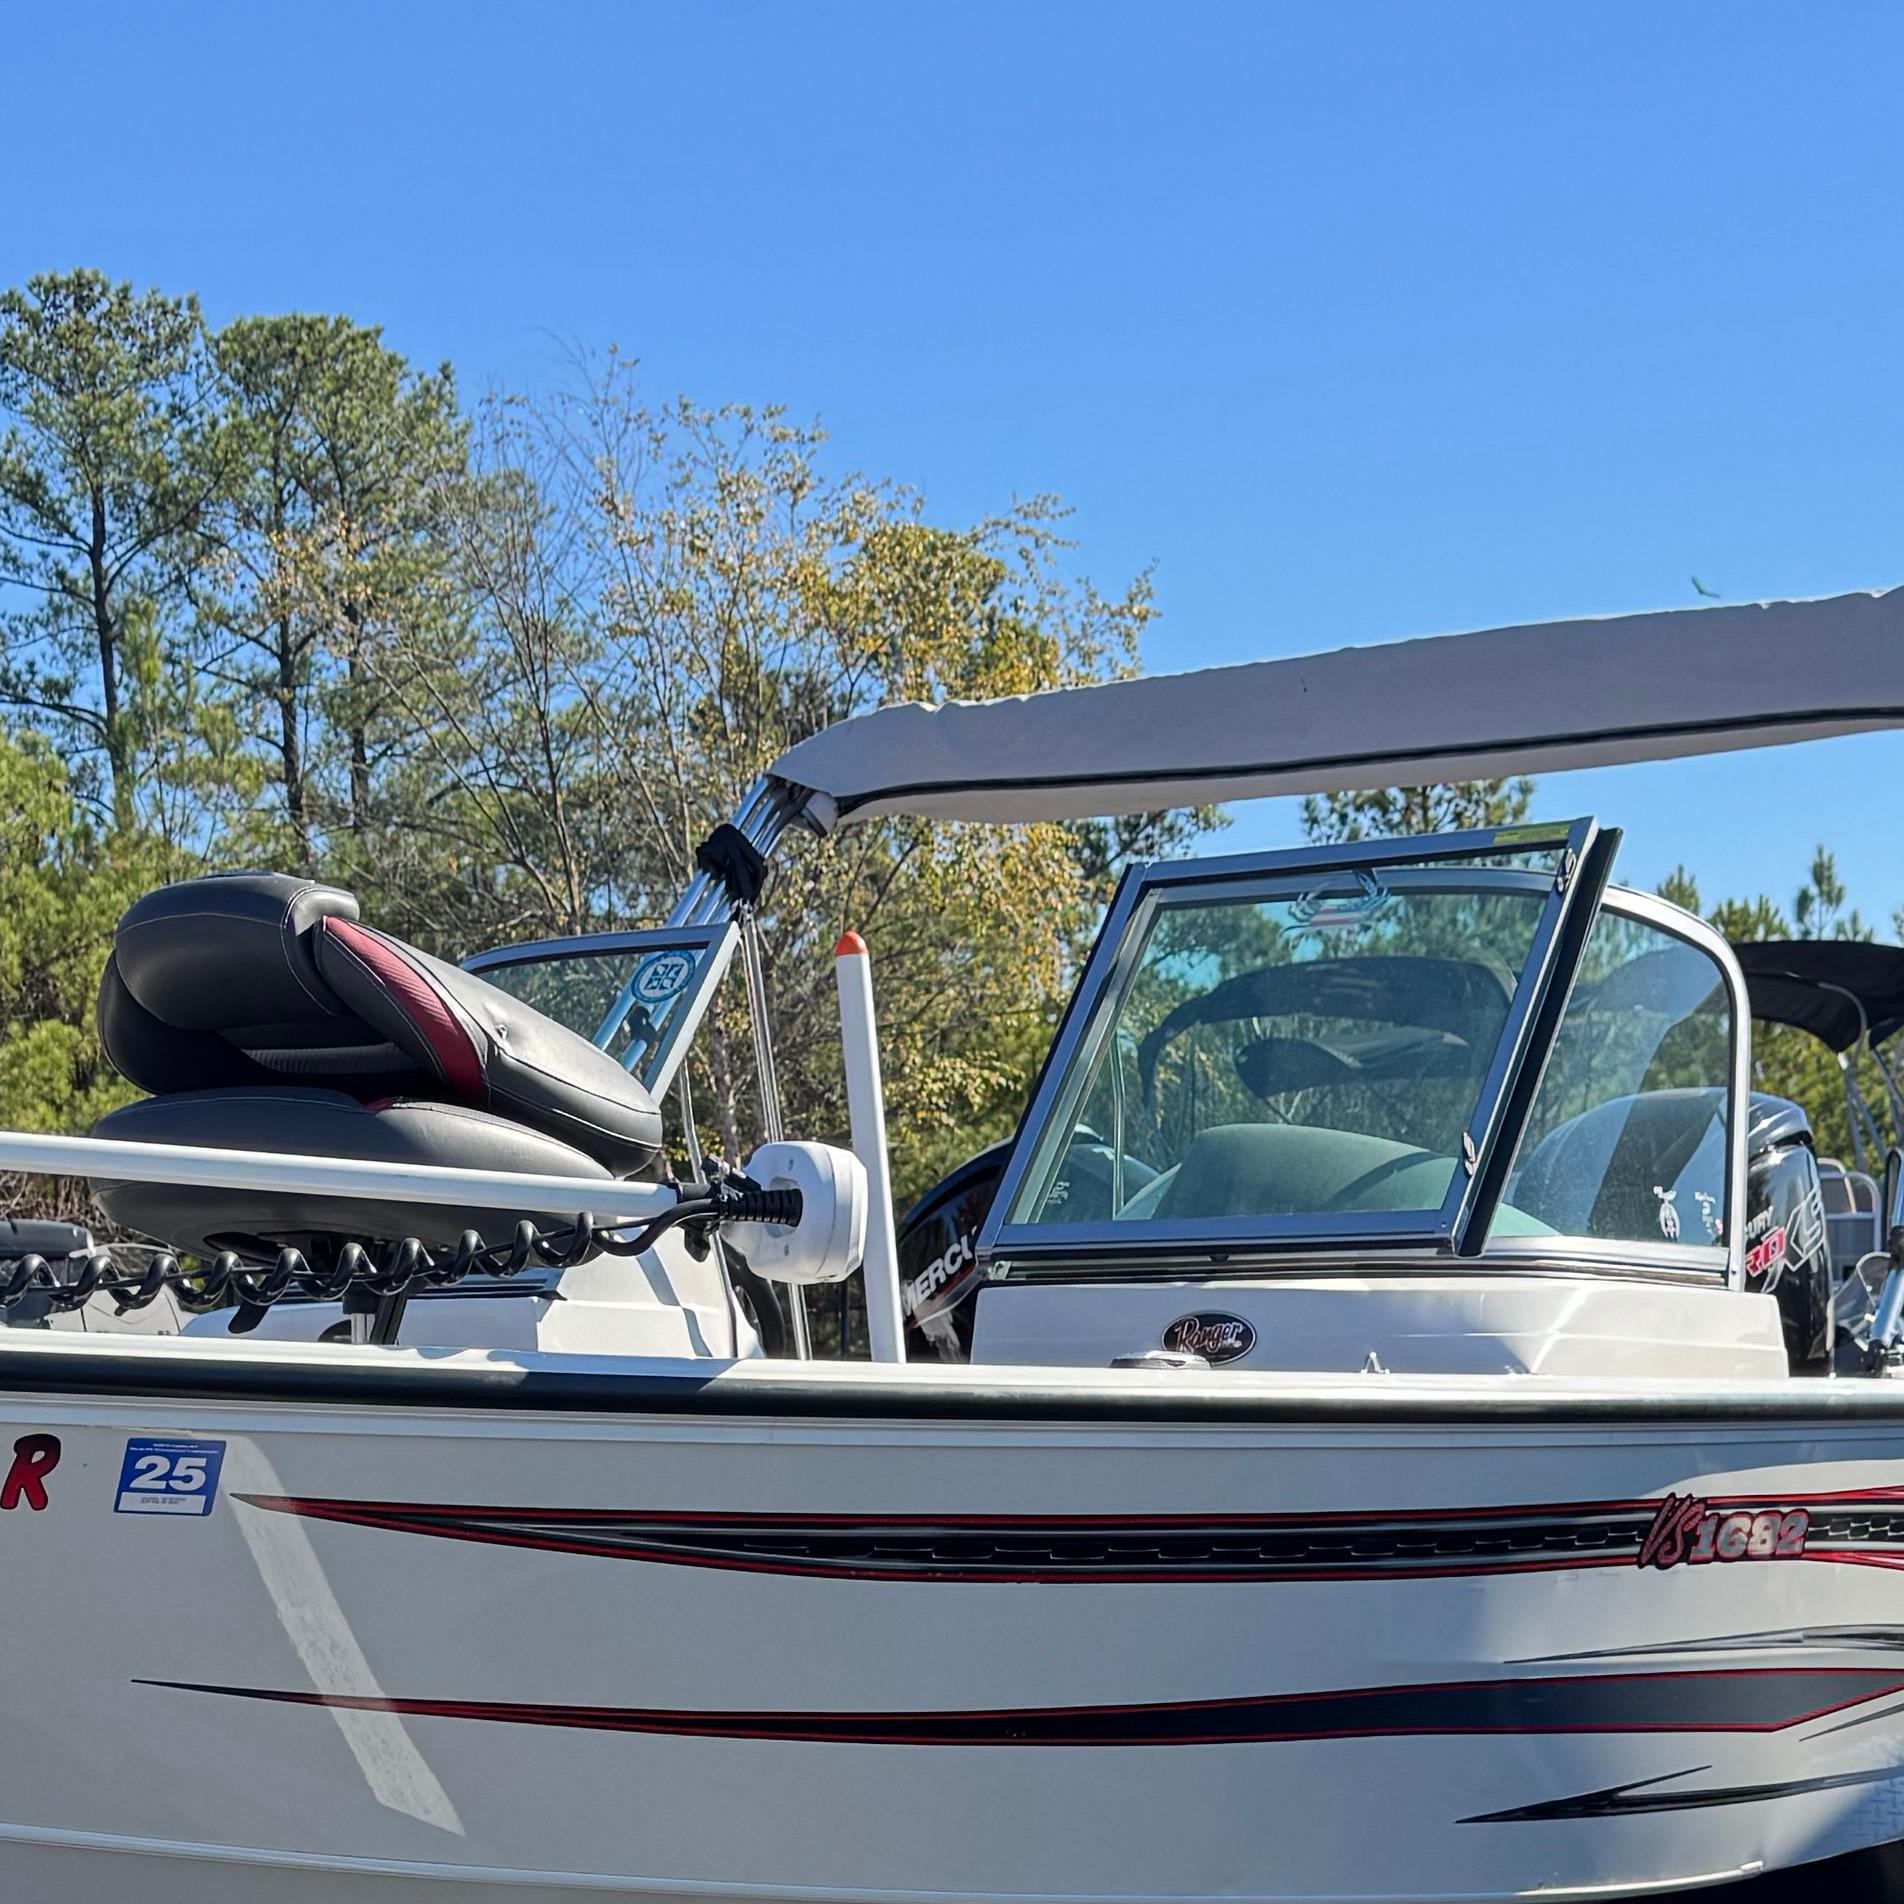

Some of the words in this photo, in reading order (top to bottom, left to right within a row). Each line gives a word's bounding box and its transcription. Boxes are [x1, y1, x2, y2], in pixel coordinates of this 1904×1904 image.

[1745, 1206, 1774, 1240] URY
[1174, 1316, 1244, 1354] Ranger
[129, 1455, 207, 1492] 25
